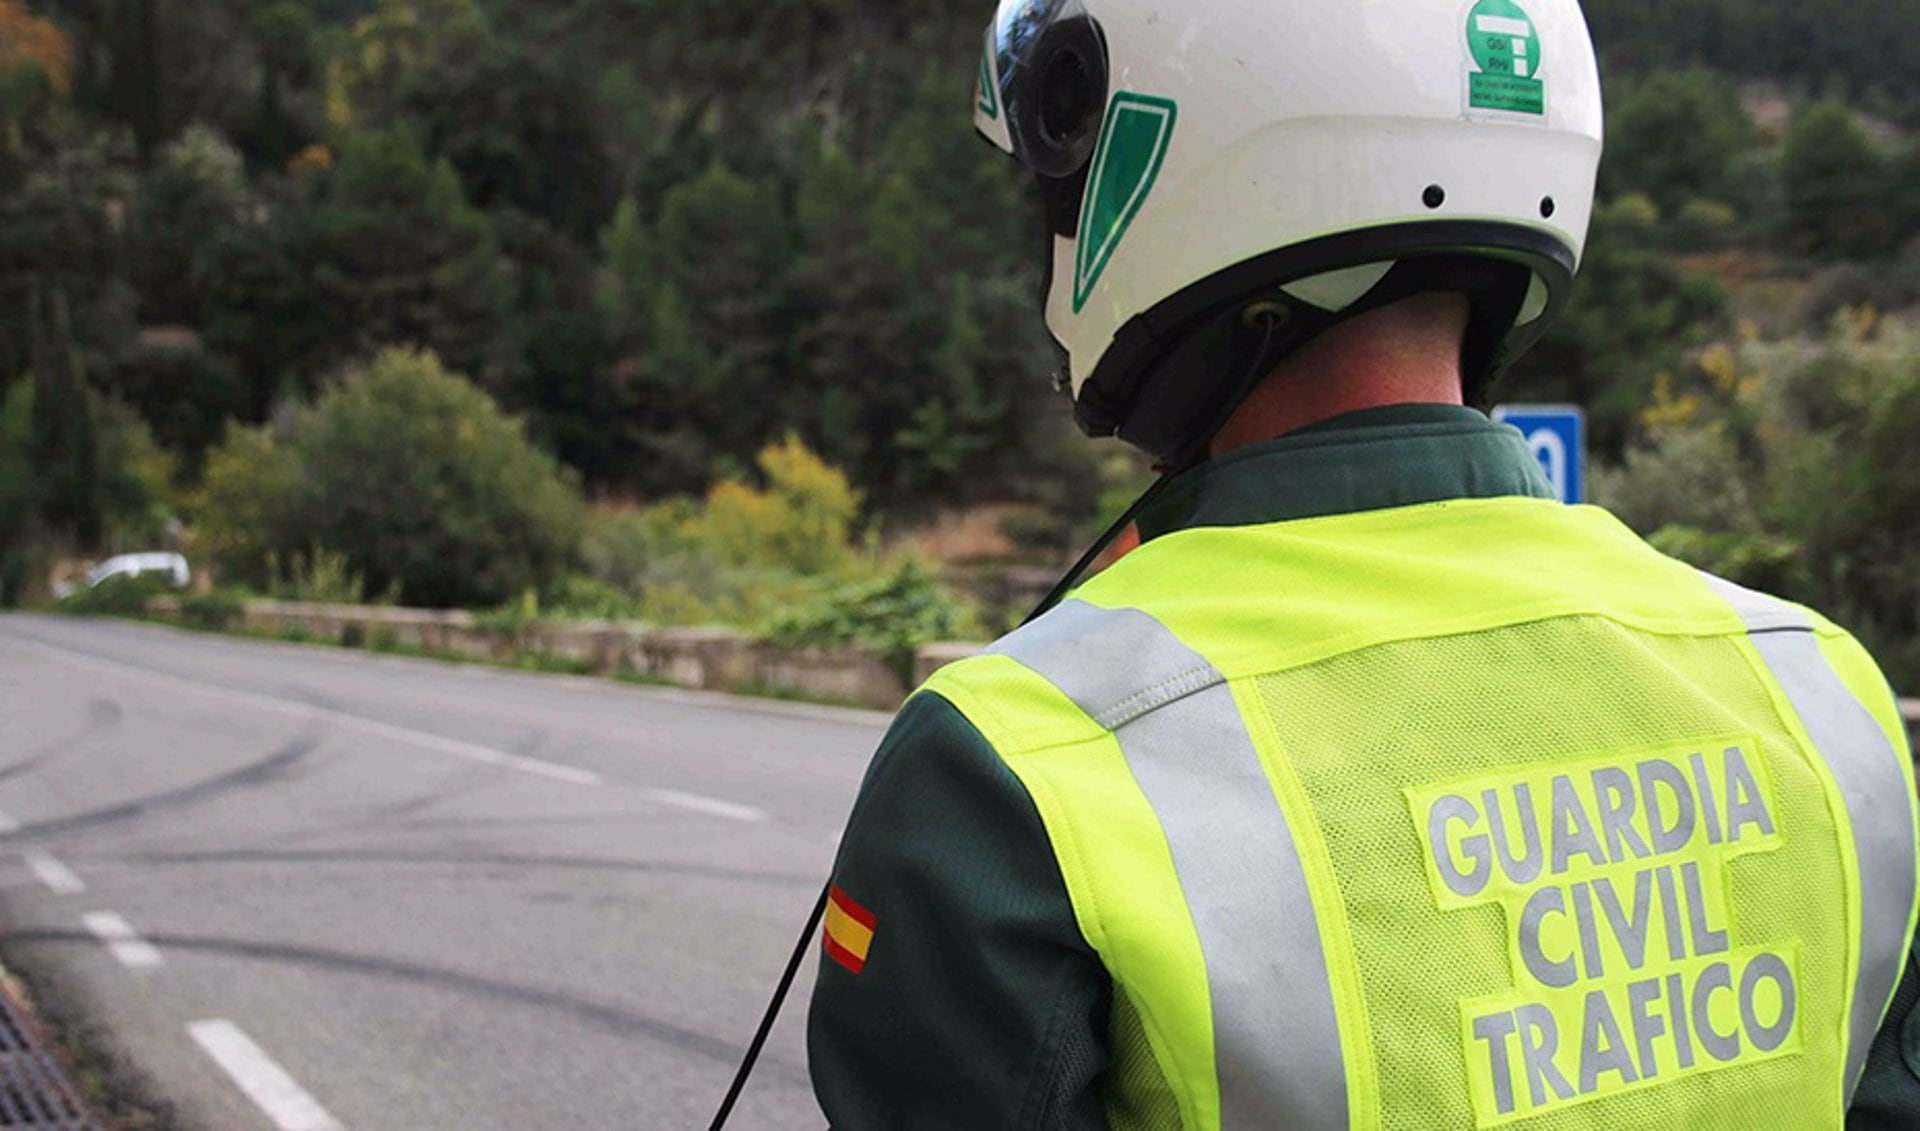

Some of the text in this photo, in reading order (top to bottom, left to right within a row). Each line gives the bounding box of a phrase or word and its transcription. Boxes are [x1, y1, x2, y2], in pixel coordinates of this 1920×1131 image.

[1428, 747, 1775, 896] GUARDIA
[1519, 861, 1728, 988] CIVIL
[1473, 953, 1796, 1115] TRAFICO
